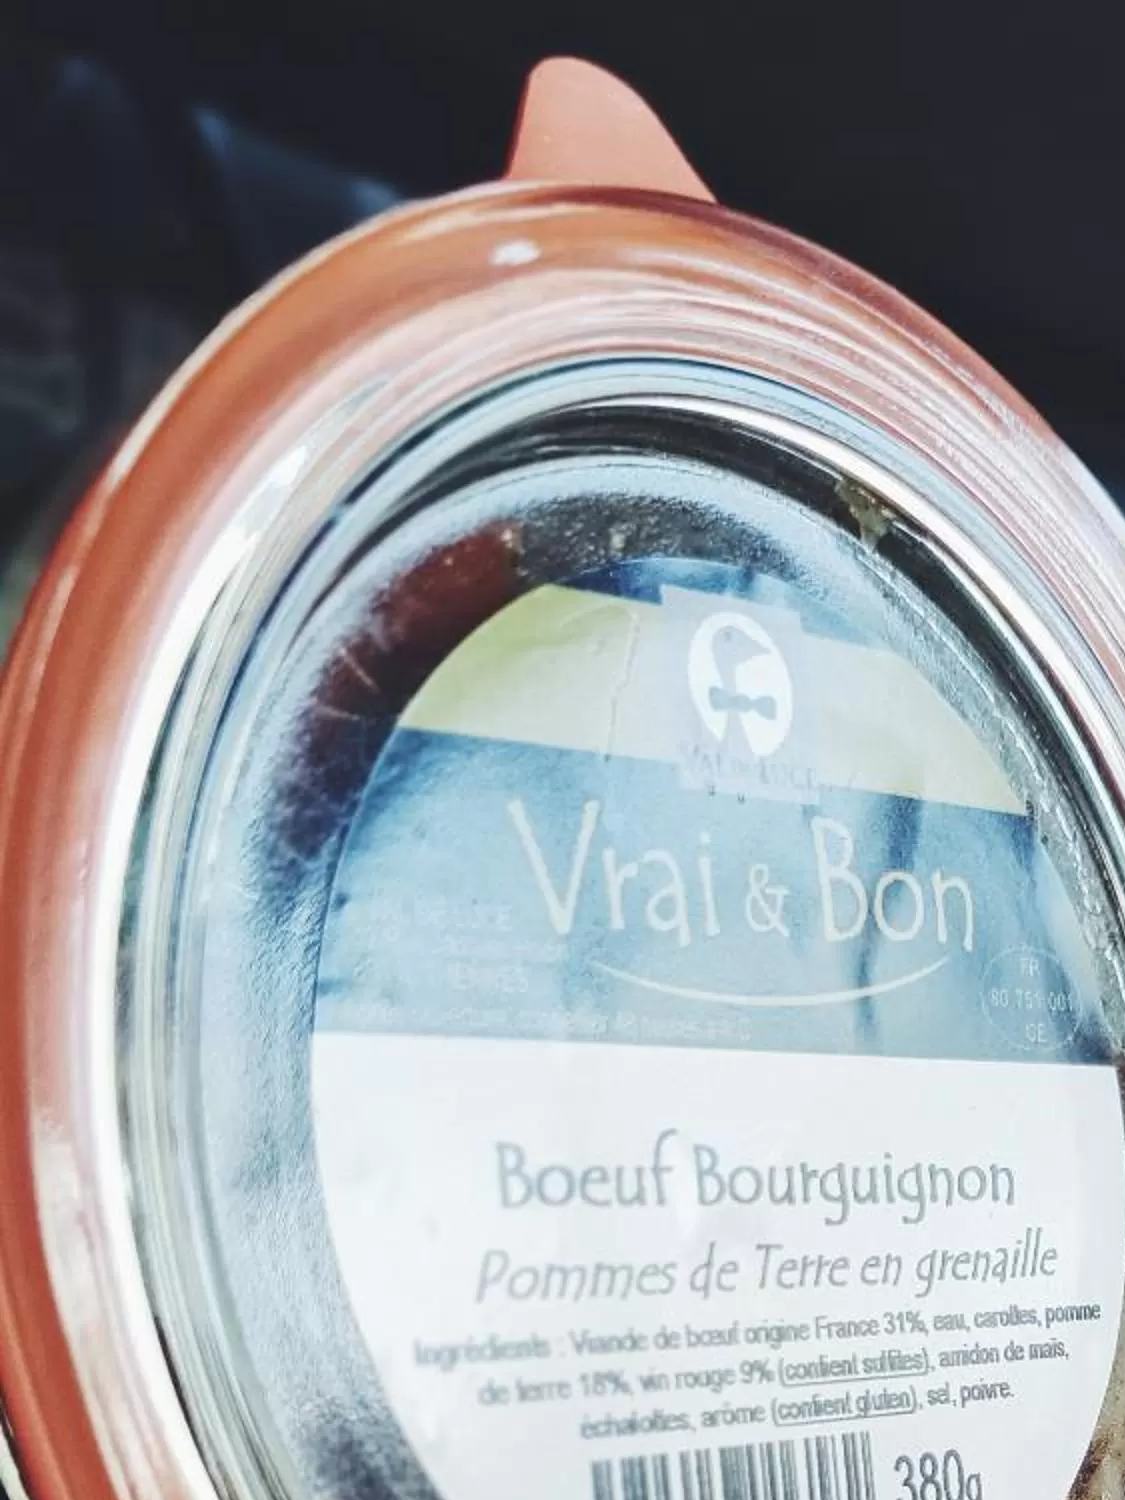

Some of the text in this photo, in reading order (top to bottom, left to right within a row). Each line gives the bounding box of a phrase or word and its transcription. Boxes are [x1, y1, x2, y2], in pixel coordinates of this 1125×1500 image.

[506, 798, 975, 953] Vrai & Bon
[496, 1127, 1016, 1226] Boeuf Bourguignon
[475, 1226, 1059, 1305] Pommes de Terre en grenaille
[568, 1328, 648, 1356] Viande
[653, 1324, 682, 1350] de
[743, 1318, 811, 1350] origine
[814, 1312, 881, 1341] France
[932, 1311, 971, 1333] eau,
[1045, 1301, 1102, 1329] pomme
[477, 1377, 510, 1407] de
[514, 1377, 573, 1405] terre
[640, 1367, 670, 1393] vin
[675, 1364, 737, 1394] rouge
[739, 1357, 777, 1384] 9%
[938, 1342, 1001, 1370] amidon
[1003, 1338, 1026, 1363] de
[926, 1381, 958, 1409] sel,
[960, 1376, 1015, 1410] poivre.
